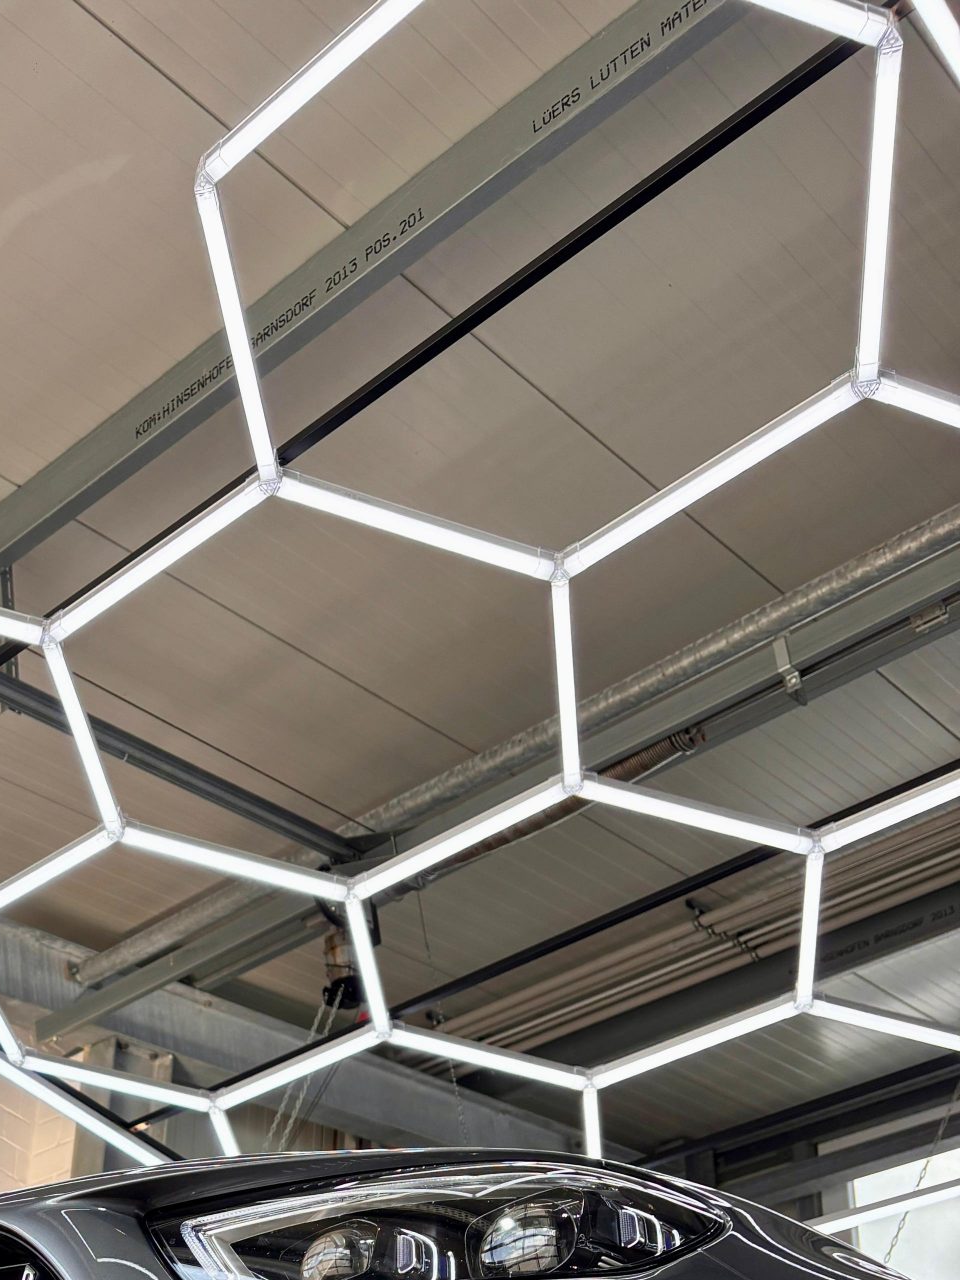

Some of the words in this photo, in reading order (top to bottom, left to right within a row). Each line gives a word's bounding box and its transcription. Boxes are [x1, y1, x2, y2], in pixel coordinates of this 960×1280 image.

[325, 257, 359, 293] 2013
[365, 207, 425, 262] POS.201
[532, 87, 581, 134] LÜERS
